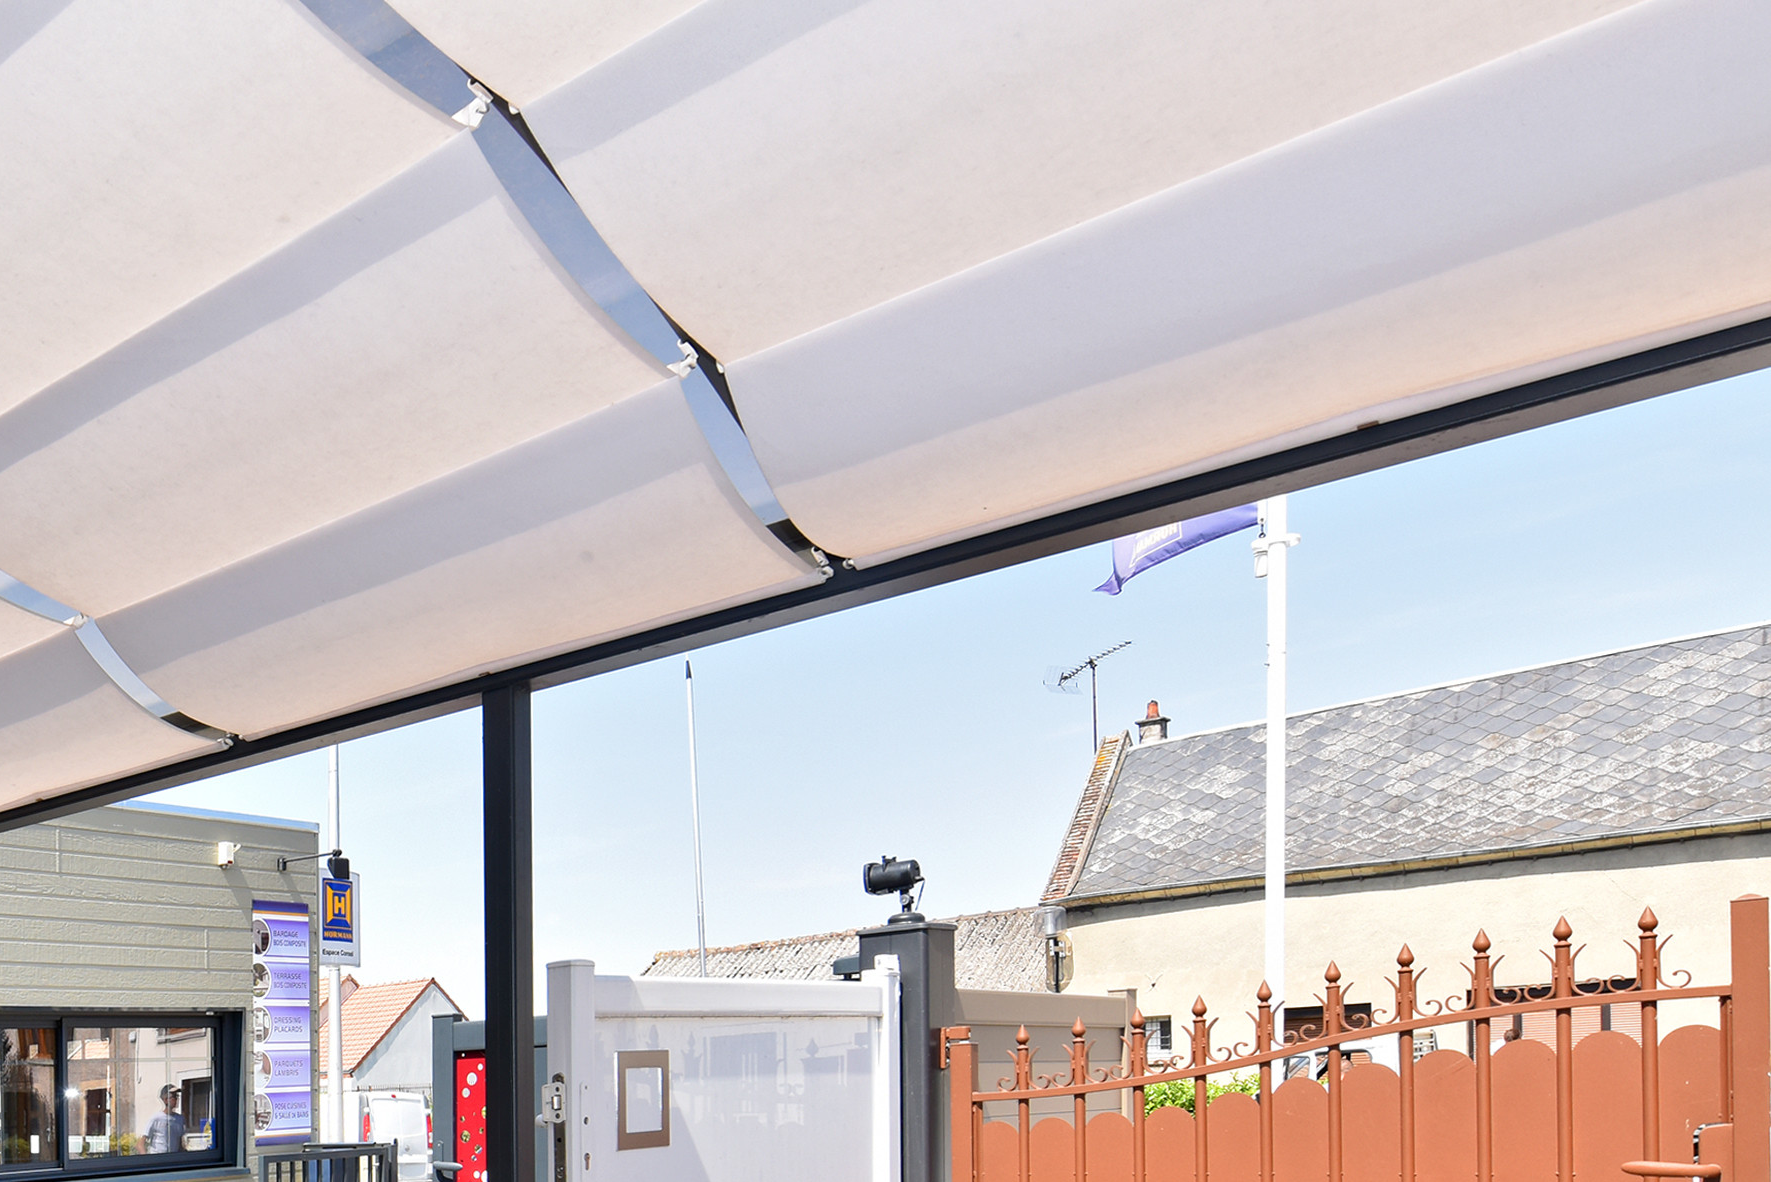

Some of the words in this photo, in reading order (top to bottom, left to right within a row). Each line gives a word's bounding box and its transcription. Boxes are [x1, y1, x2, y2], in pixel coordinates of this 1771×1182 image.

[334, 896, 345, 914] H
[273, 930, 298, 938] BARDAGE
[322, 948, 339, 957] Espace
[274, 972, 302, 980] TERRASSE
[274, 1016, 302, 1024] DRESSING
[274, 1060, 303, 1068] PARQUETS
[274, 1069, 299, 1077] LAMBRIS
[274, 1102, 286, 1110] POSE
